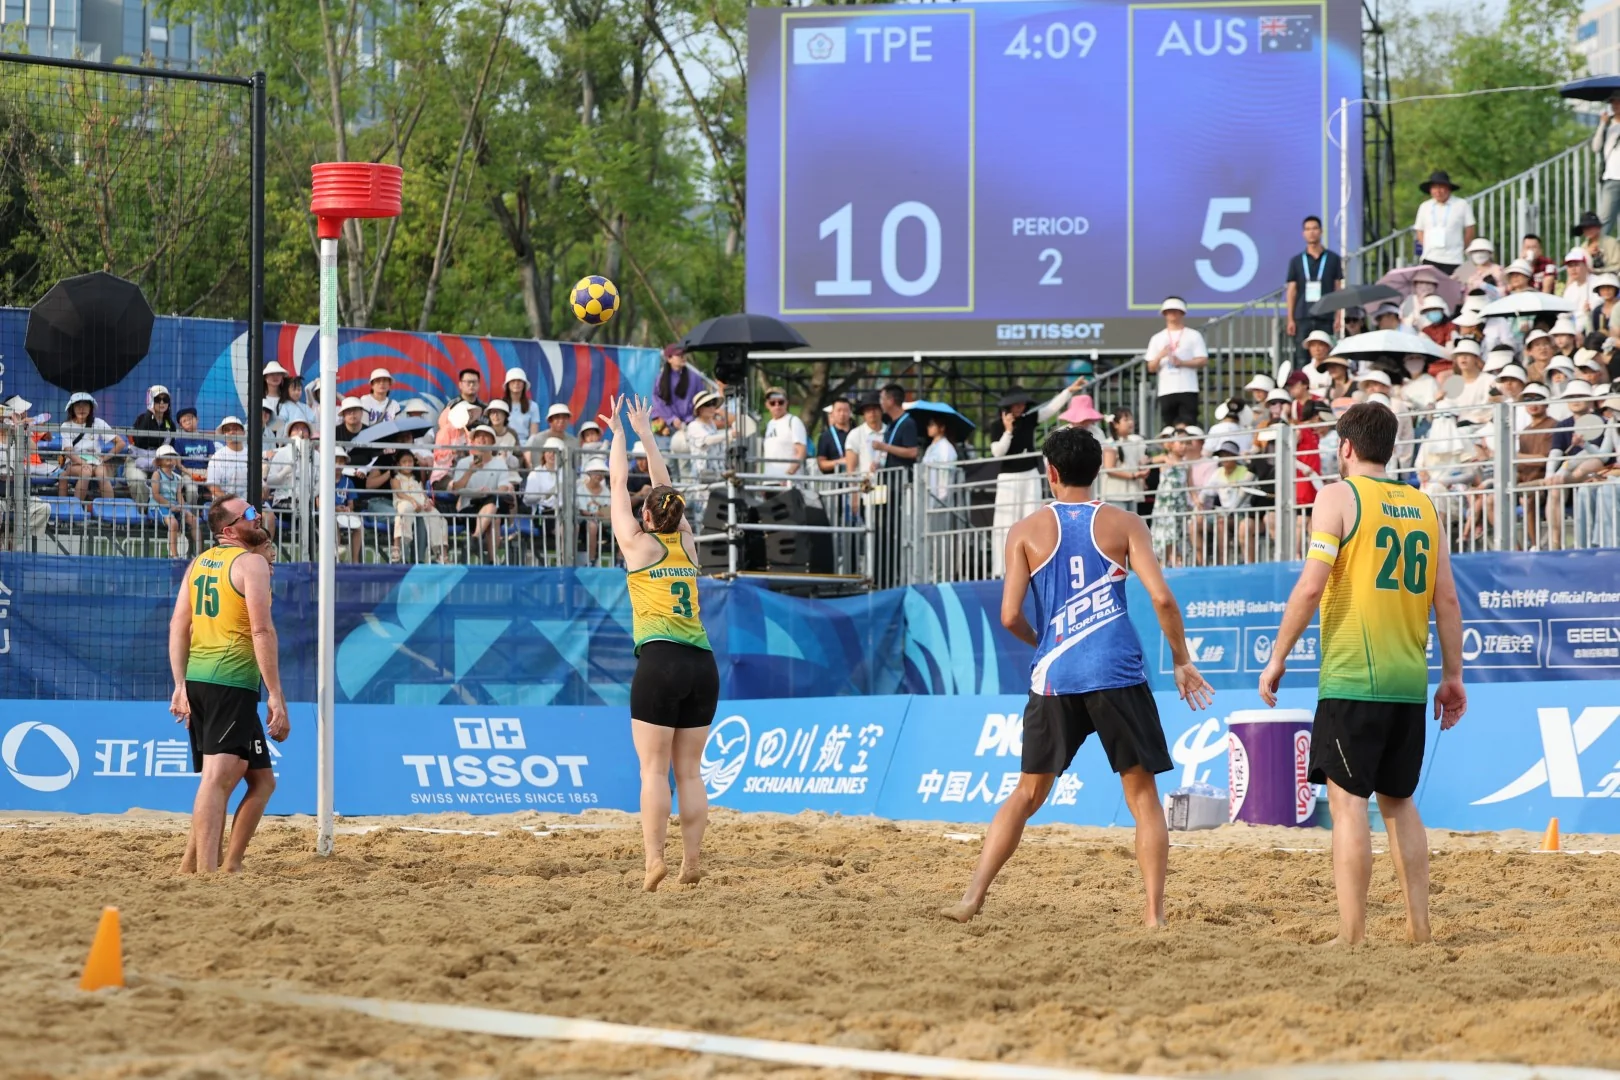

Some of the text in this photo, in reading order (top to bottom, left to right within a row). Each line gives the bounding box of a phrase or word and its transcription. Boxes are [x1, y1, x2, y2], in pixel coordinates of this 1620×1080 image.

[856, 26, 932, 63] TPE
[1003, 22, 1097, 60] 4:09
[1156, 18, 1247, 56] AUS
[1012, 216, 1089, 237] PERIOD
[815, 201, 942, 297] 10
[1194, 197, 1259, 292] 5
[1039, 248, 1063, 286] 2
[1027, 323, 1105, 339] TISSOT
[1070, 556, 1085, 589] 9
[1375, 526, 1430, 595] 26
[193, 574, 220, 617] 15
[671, 582, 692, 617] 3
[1050, 584, 1114, 635] TPE
[1478, 589, 1549, 608] 官方合作伙伴
[1550, 591, 1585, 604] Official
[1068, 604, 1121, 634] KORFBALL
[1483, 634, 1534, 653] 亚信安全
[754, 723, 884, 774] 四川航空
[402, 755, 589, 787] TISSOT
[743, 777, 868, 794] SICHUAN AIRLINES
[411, 793, 598, 804] SWISS WATCHES SINCE 1853
